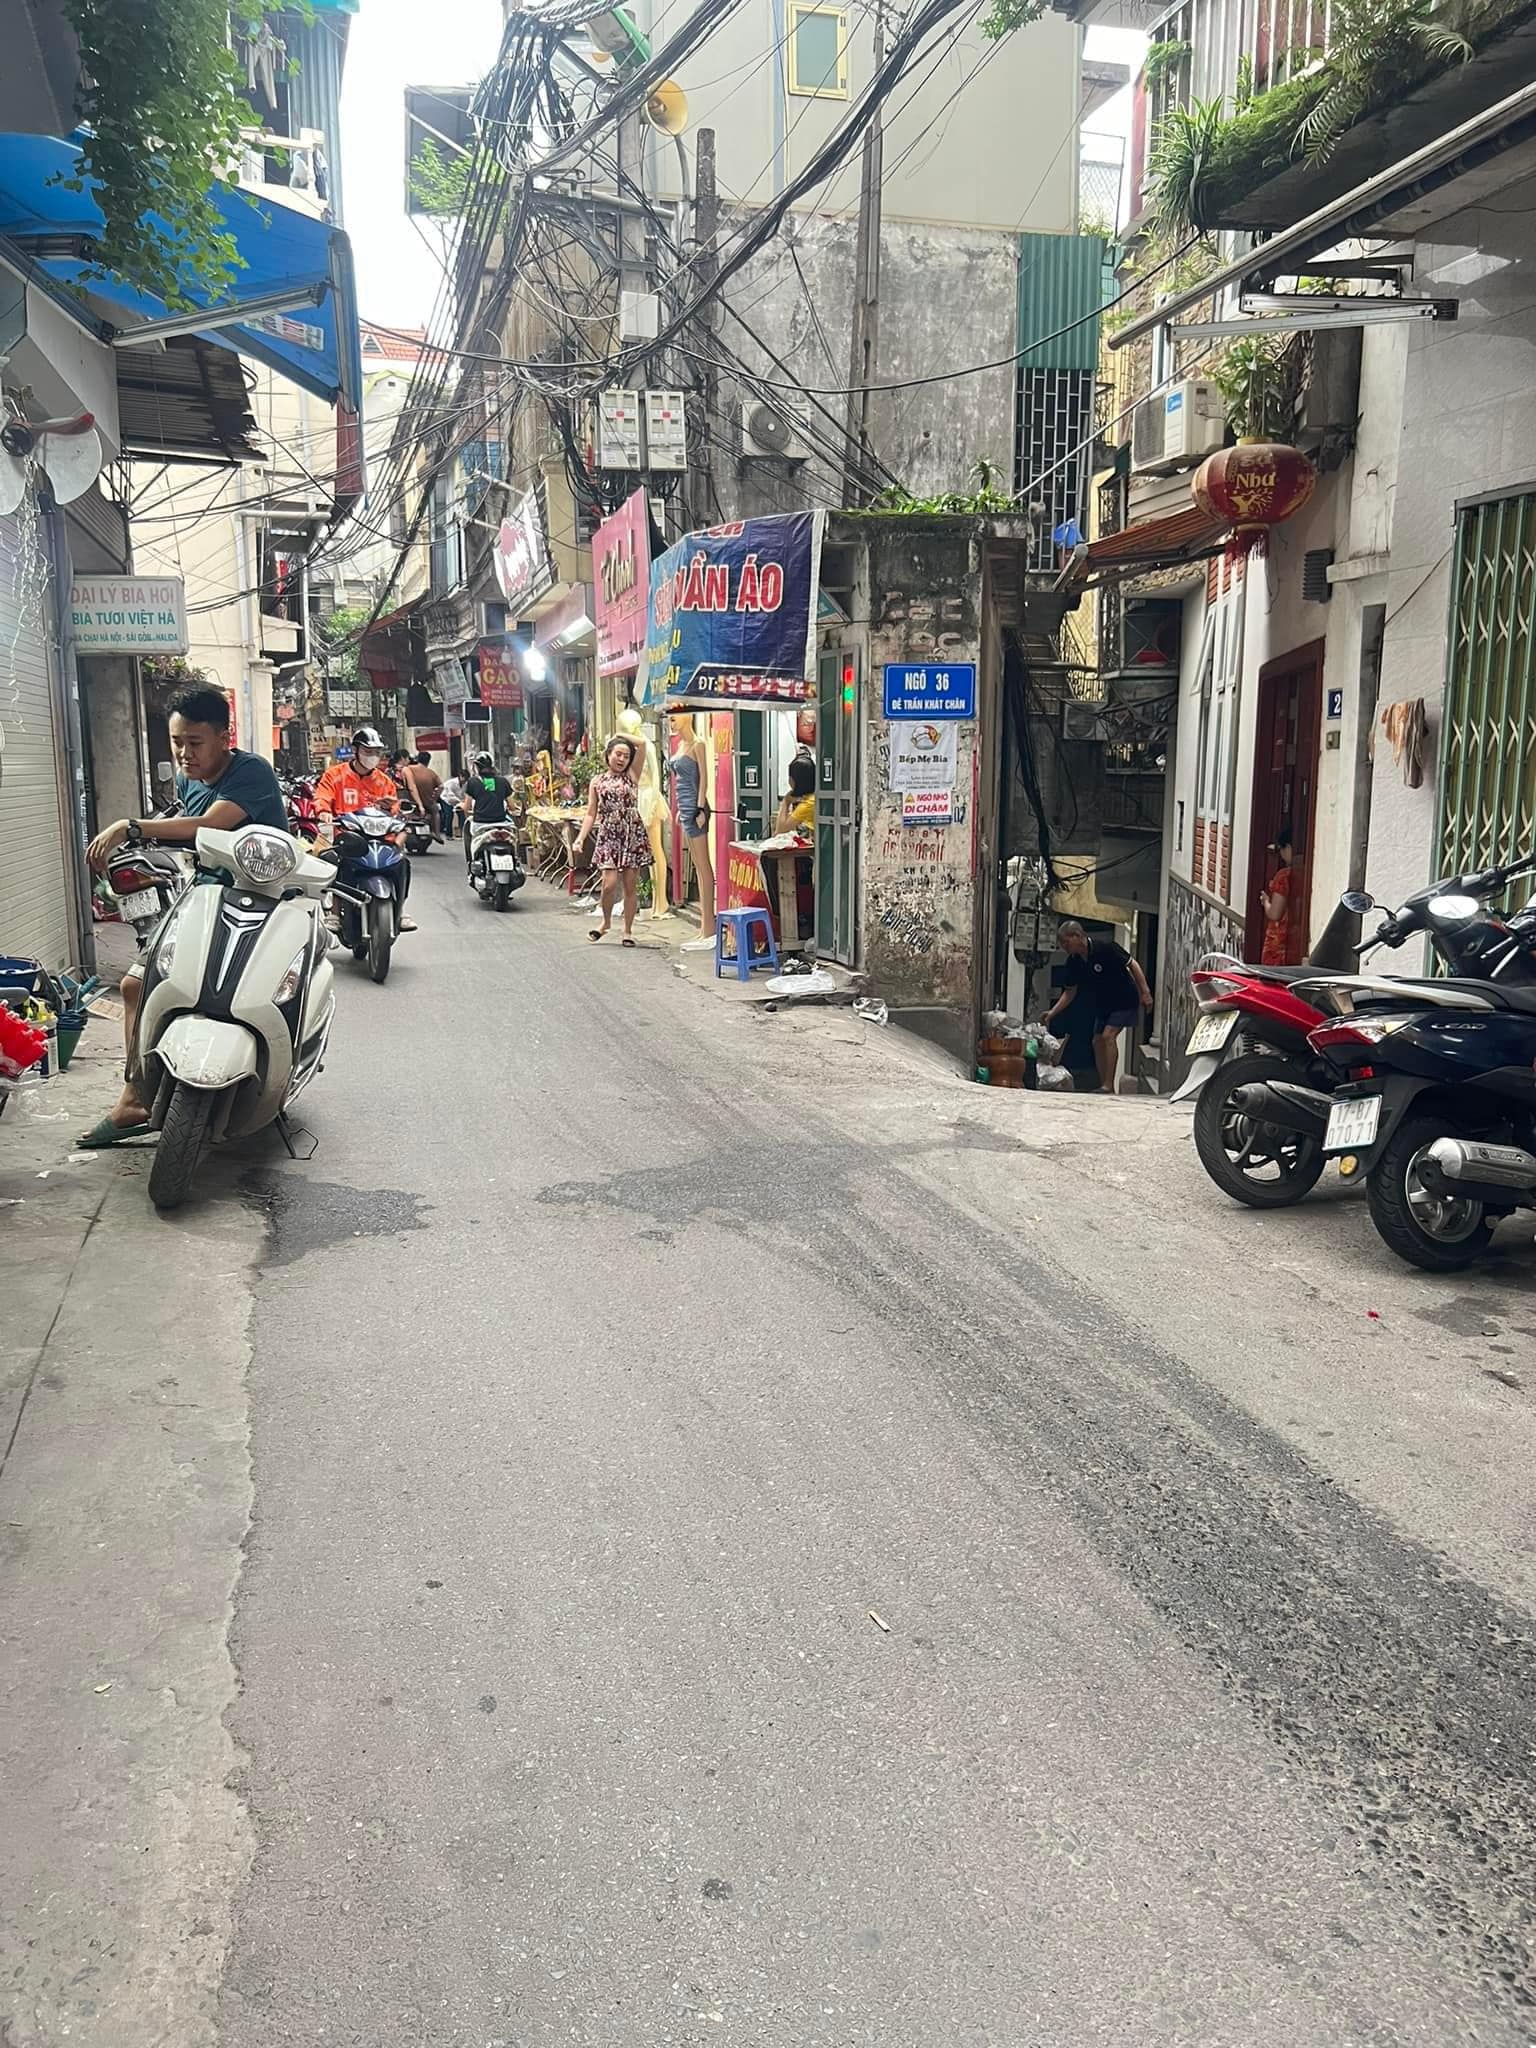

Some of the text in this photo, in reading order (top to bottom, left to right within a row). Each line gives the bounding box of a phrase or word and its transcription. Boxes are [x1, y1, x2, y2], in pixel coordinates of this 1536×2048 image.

[1237, 472, 1276, 489] Như
[100, 582, 117, 604] LÝ
[121, 587, 145, 604] BIA
[735, 554, 783, 613] ÁO
[72, 612, 93, 625] BIA
[96, 611, 125, 625] TƯƠI
[128, 609, 155, 629] VIỆT
[483, 668, 520, 688] GẠO
[935, 673, 950, 691] 36
[1334, 694, 1341, 713] 2
[933, 754, 948, 763] Bia
